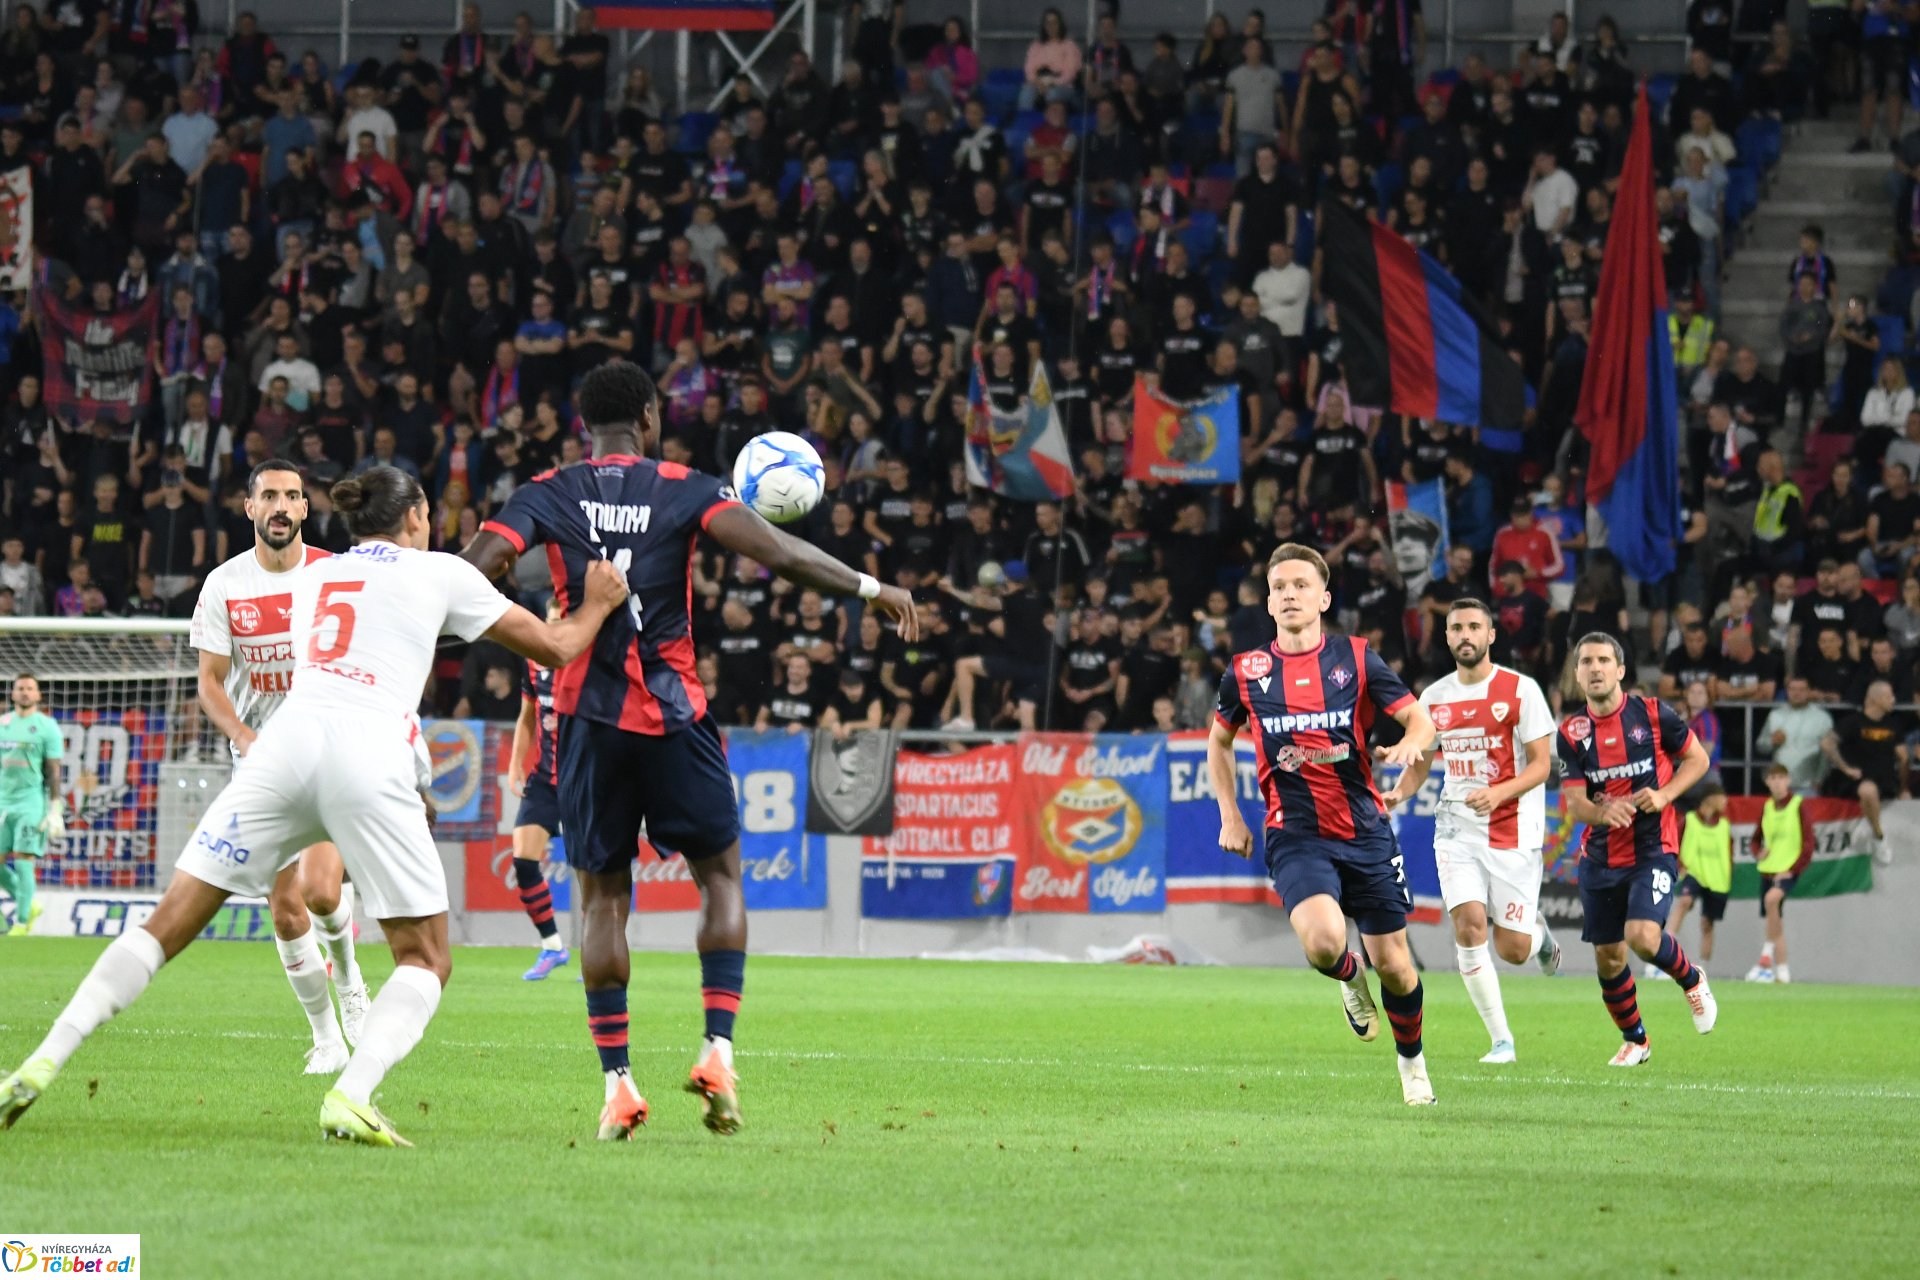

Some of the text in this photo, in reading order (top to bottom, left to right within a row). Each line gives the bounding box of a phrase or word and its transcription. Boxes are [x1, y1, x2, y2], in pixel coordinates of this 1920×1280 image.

[307, 580, 366, 664] 5
[1022, 742, 1161, 777] Old School
[894, 792, 998, 818] SPARTACUS
[1020, 866, 1158, 906] Best Style
[1652, 868, 1671, 894] 18
[1505, 902, 1524, 923] 24
